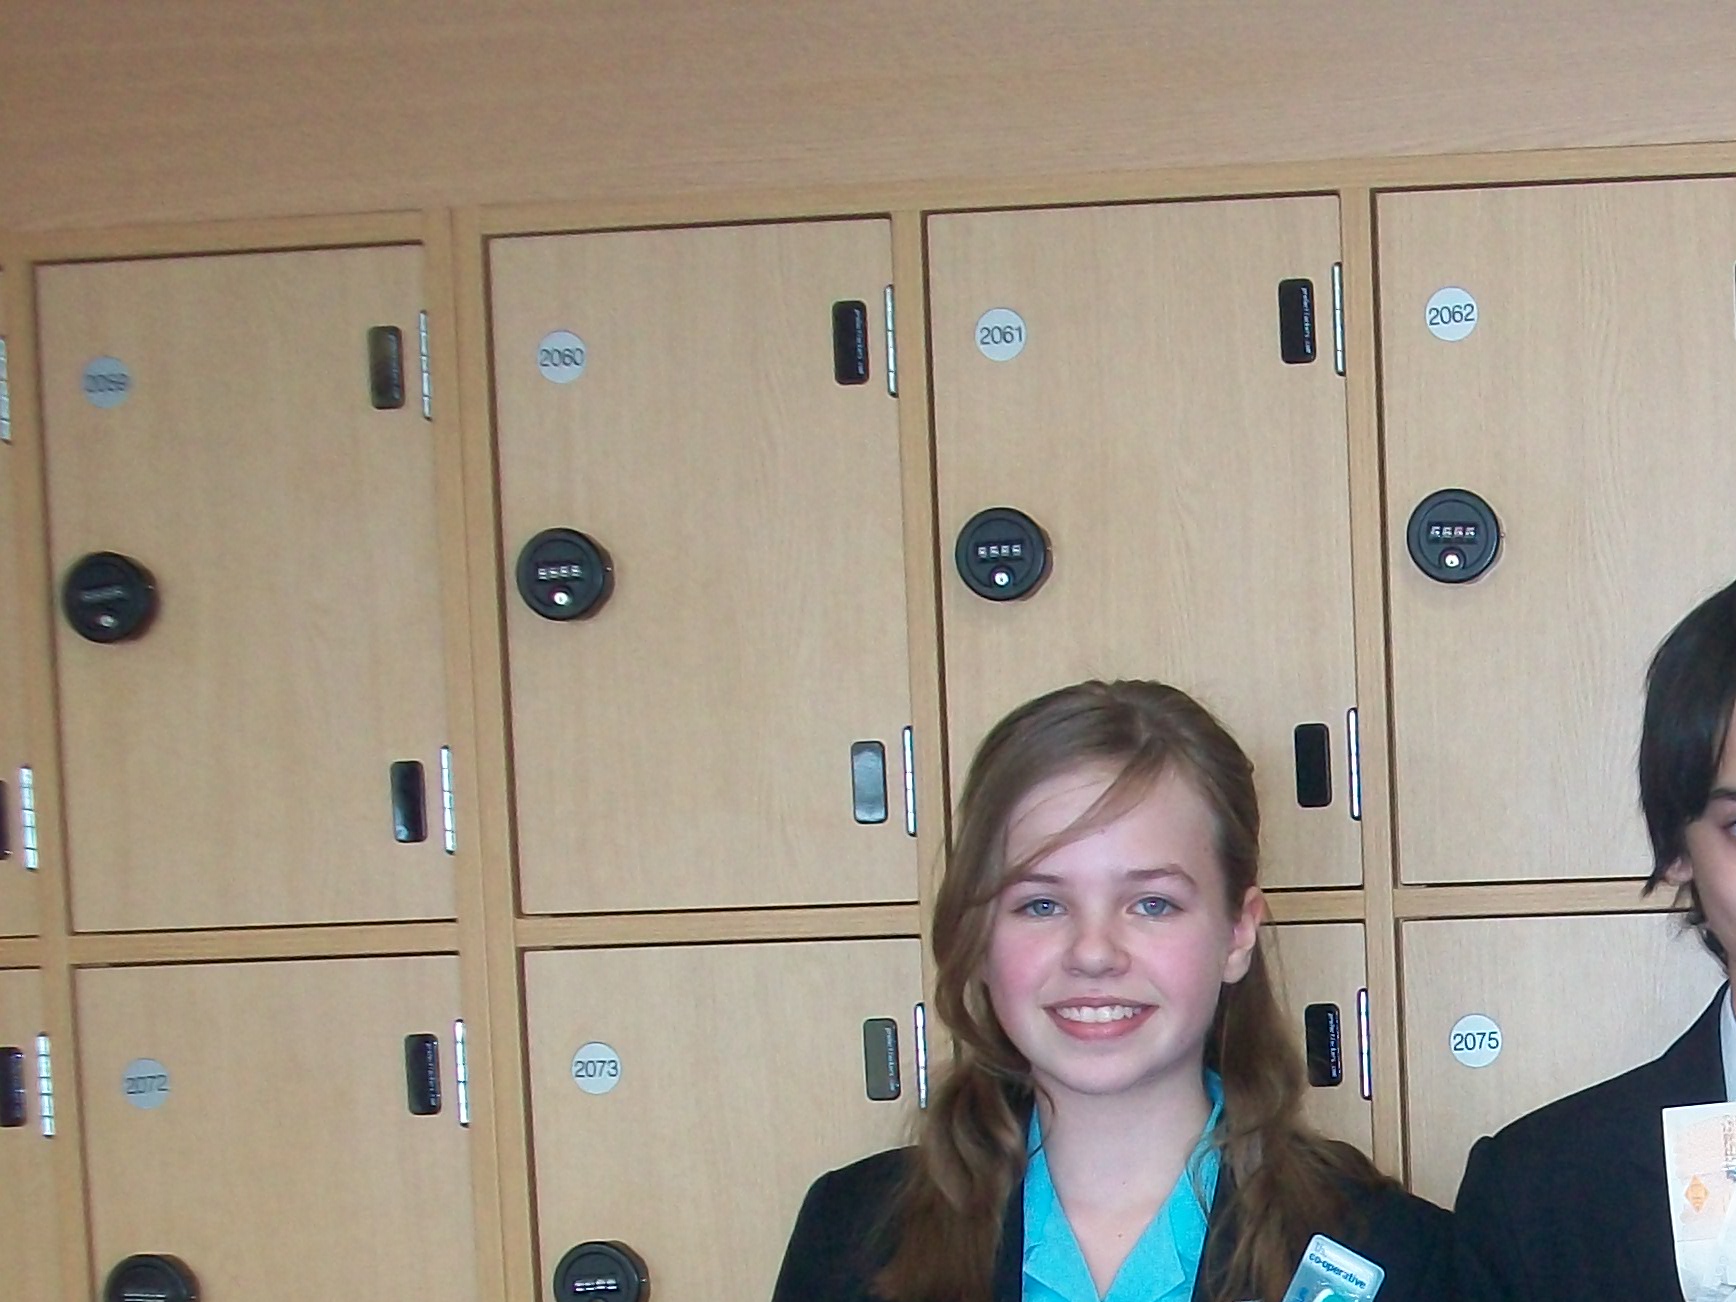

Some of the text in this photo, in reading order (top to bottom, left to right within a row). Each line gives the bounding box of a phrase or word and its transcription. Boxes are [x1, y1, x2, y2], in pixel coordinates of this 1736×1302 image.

[1429, 304, 1475, 326] 2062
[980, 326, 1023, 345] 2061
[540, 348, 584, 367] 2060
[1453, 1031, 1499, 1051] 2075
[574, 1060, 618, 1078] 2073
[126, 1075, 168, 1095] 2072
[1309, 1252, 1367, 1290] co-operative
